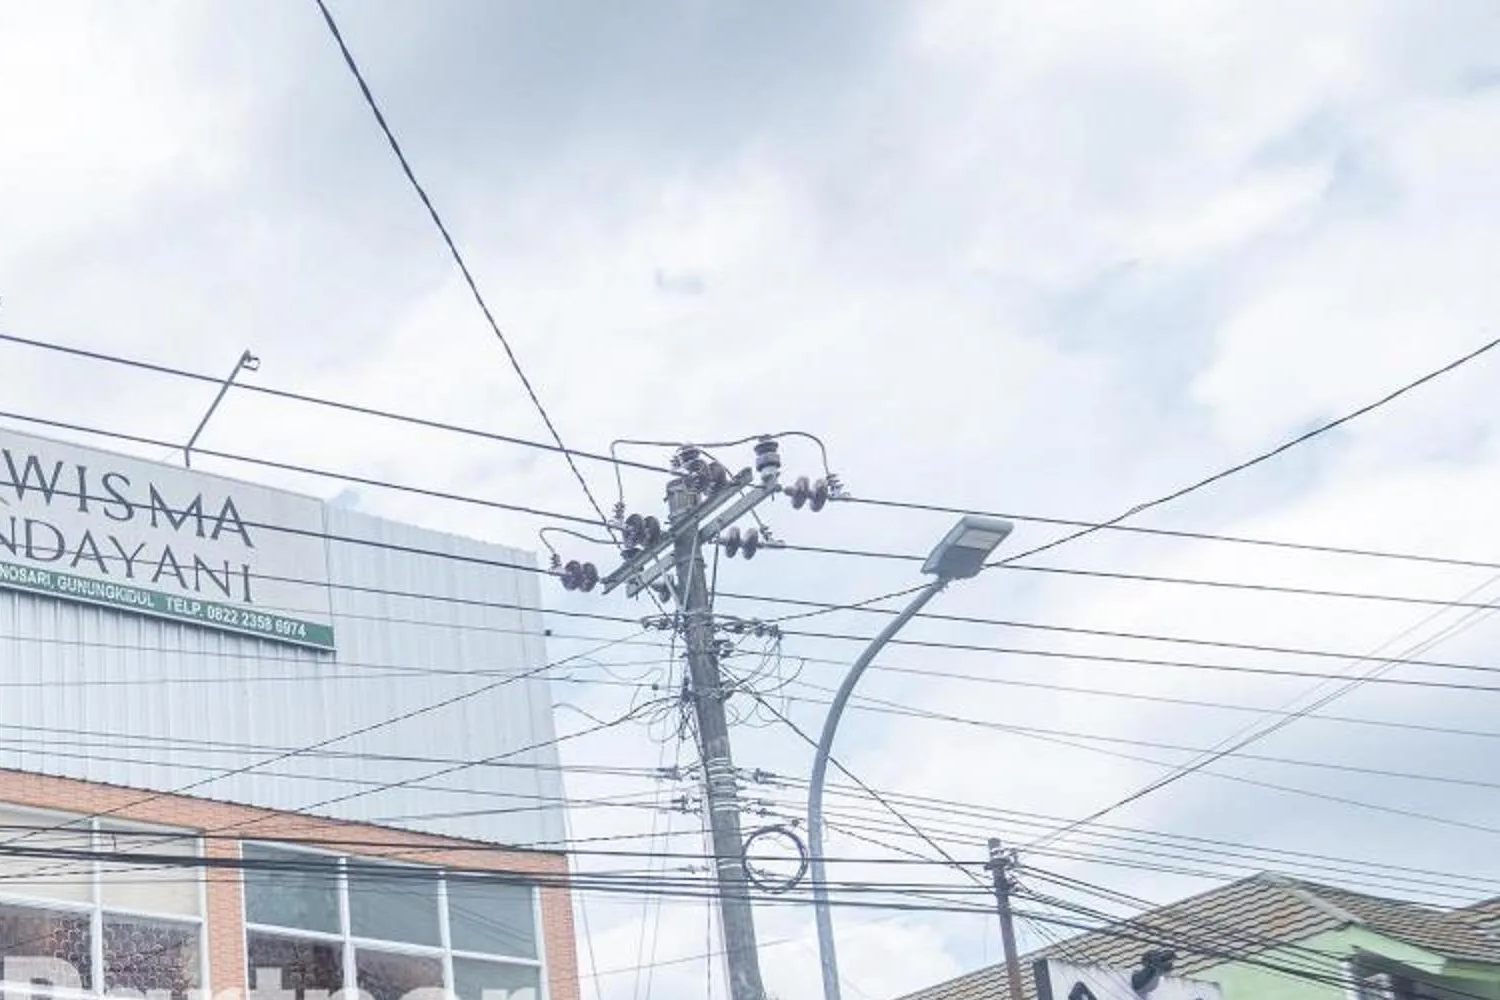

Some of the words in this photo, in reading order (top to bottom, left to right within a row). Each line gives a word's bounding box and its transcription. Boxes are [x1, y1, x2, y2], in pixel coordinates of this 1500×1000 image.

[2, 448, 255, 547] WISMA
[57, 574, 155, 607] GUNUNGKIDUL
[207, 605, 238, 625] 0822
